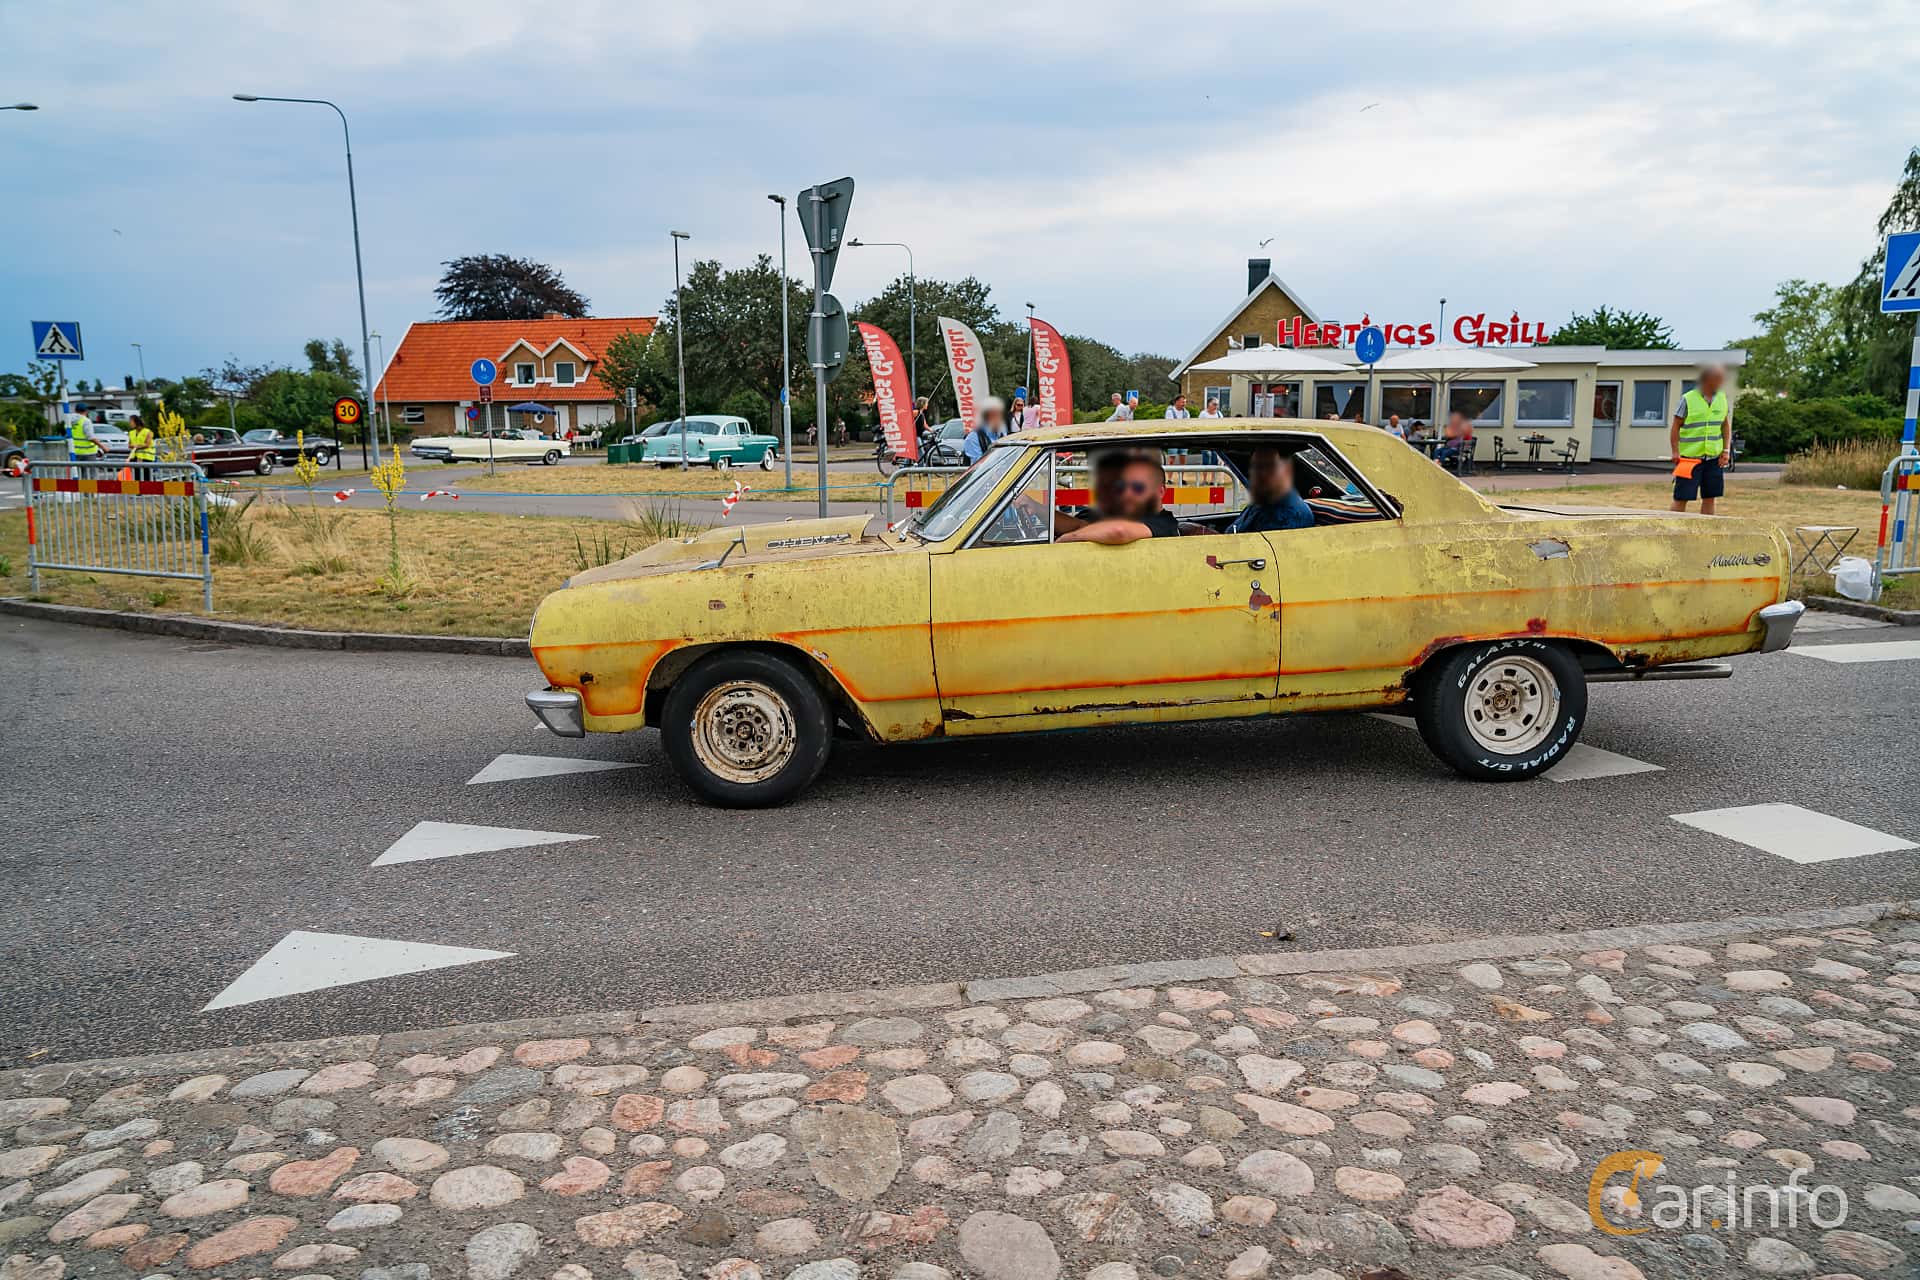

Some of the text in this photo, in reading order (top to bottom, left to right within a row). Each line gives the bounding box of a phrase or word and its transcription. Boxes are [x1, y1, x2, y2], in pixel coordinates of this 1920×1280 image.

[1277, 312, 1435, 348] HERTGS
[340, 405, 356, 417] 30
[767, 533, 852, 549] CHEVY
[1457, 639, 1530, 689] GALAXY
[1478, 716, 1576, 771] RADIAL G/T
